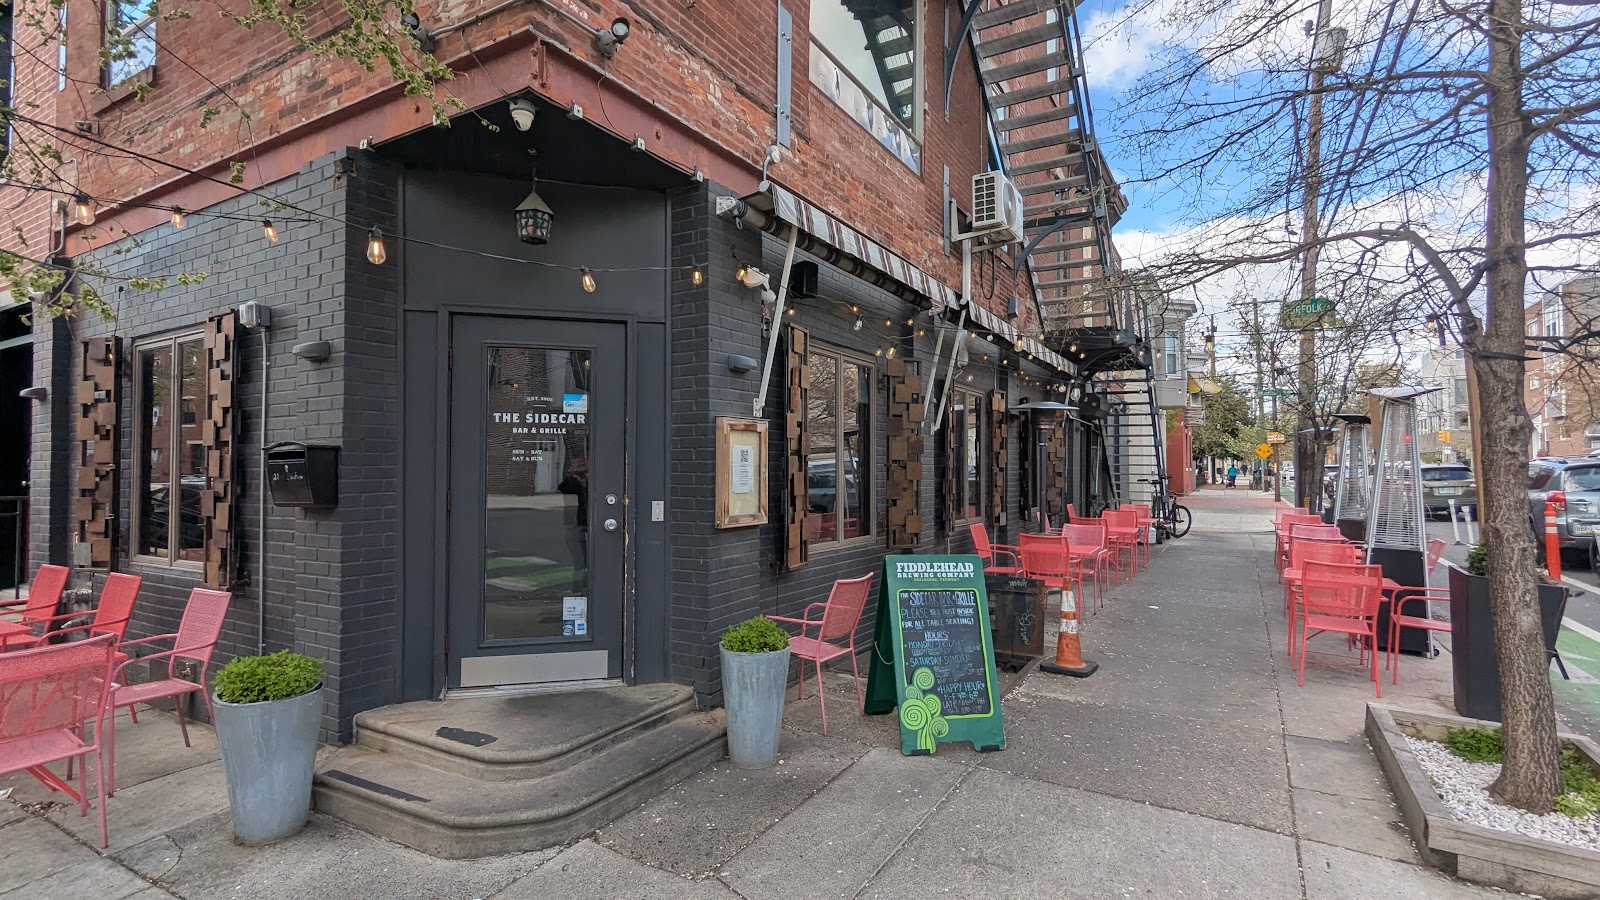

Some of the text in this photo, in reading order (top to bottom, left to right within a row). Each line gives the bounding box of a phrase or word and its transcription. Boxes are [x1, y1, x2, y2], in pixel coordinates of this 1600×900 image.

[493, 412, 586, 424] THE SIDECAR
[896, 562, 974, 573] FIDDLEHEAD
[909, 591, 939, 606] SIDECAR
[955, 591, 975, 606] GRILLE
[901, 608, 929, 619] PLEASE
[929, 608, 941, 616] SEE
[901, 620, 913, 628] FOR
[914, 620, 925, 628] ALL
